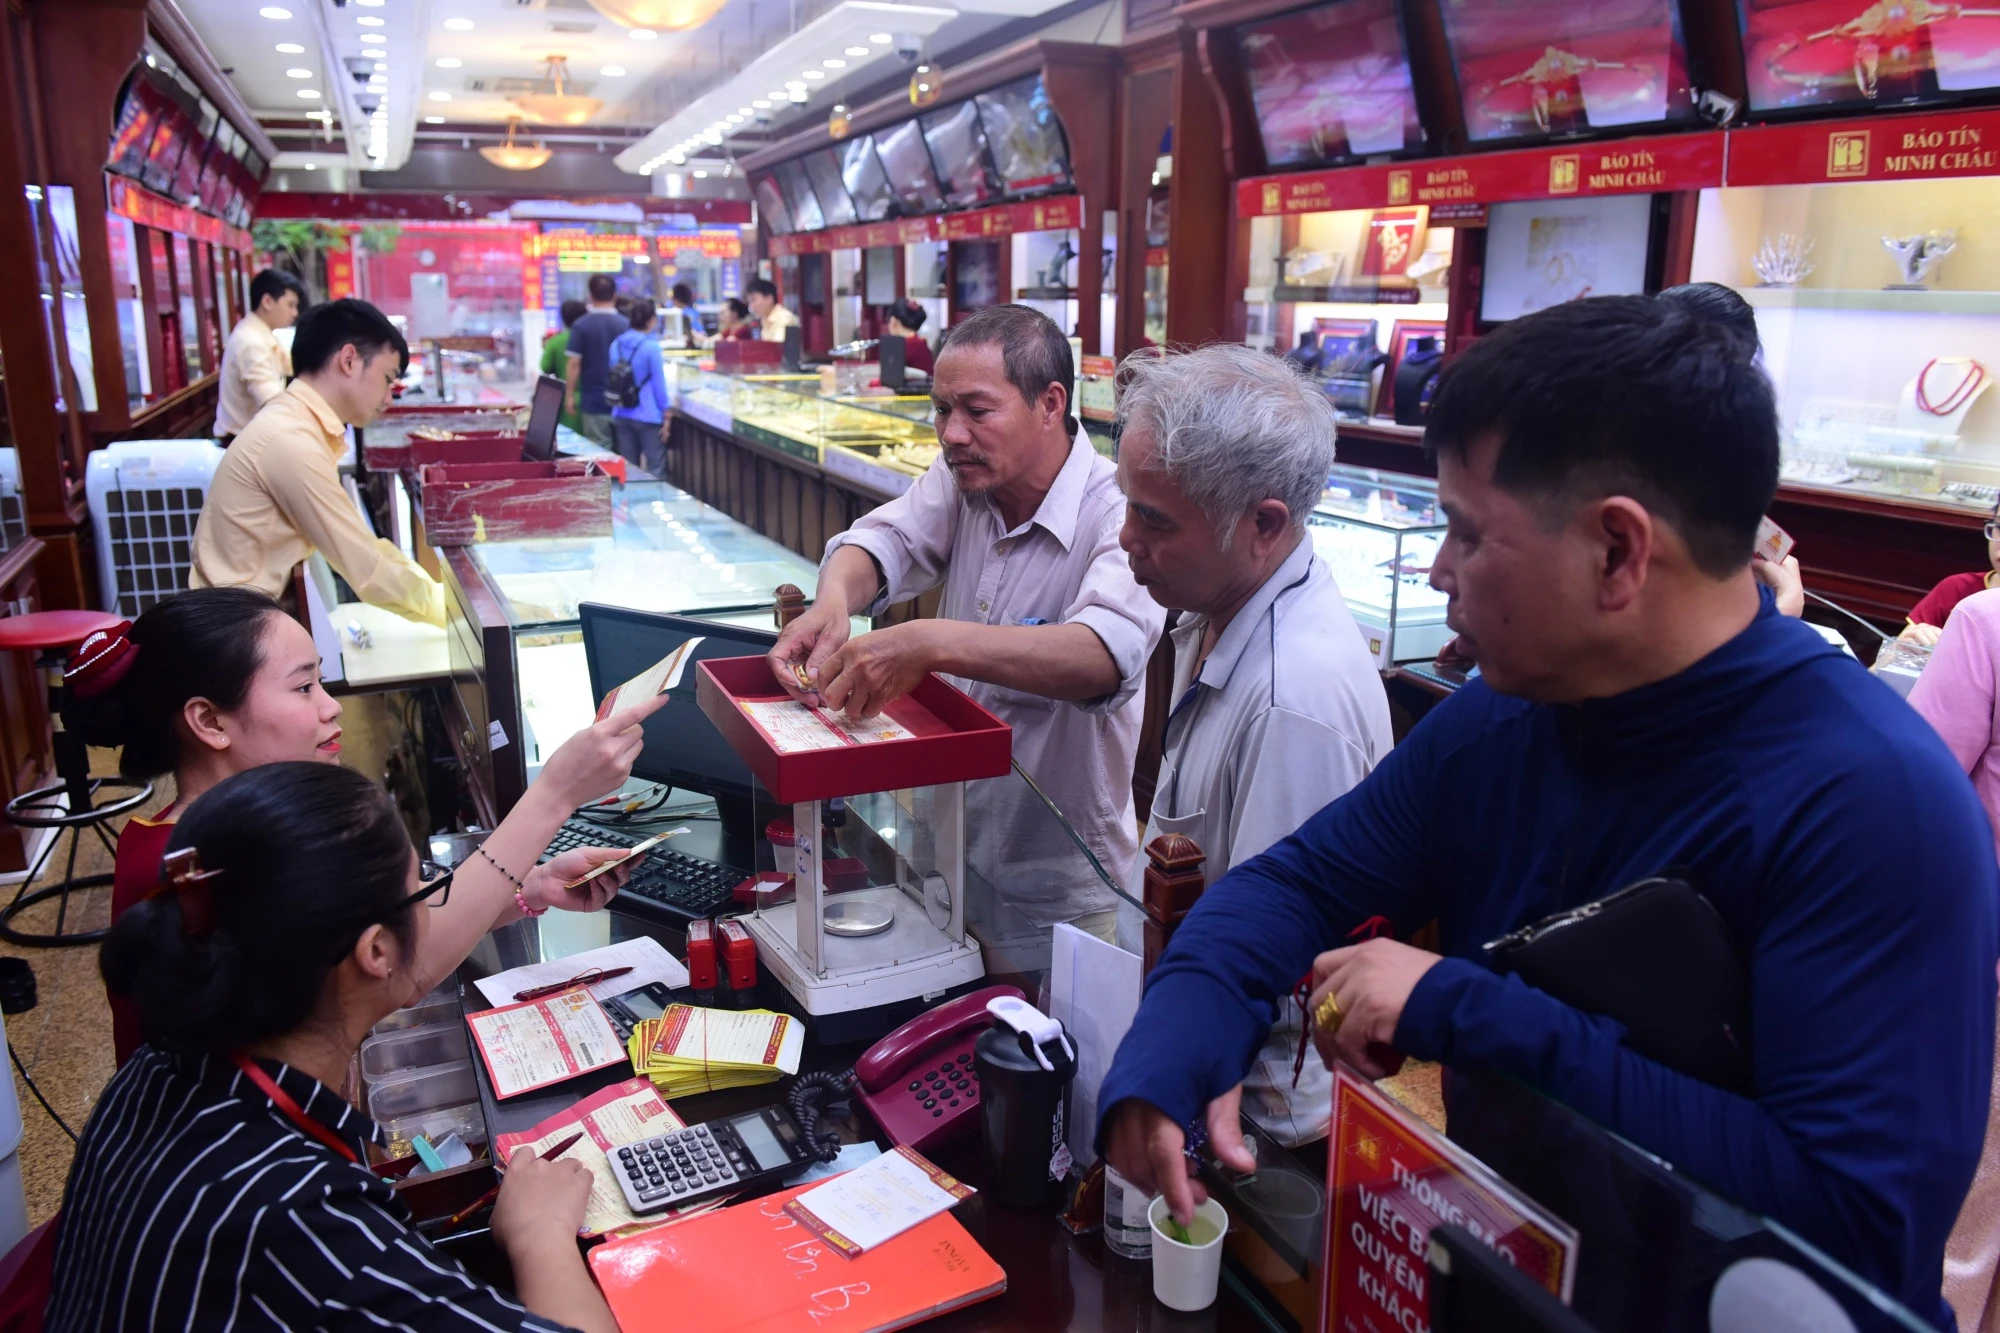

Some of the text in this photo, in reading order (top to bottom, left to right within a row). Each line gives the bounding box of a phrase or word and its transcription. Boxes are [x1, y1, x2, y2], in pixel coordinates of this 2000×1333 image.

[1902, 124, 1982, 149] BẢO TÍN
[1601, 149, 1656, 170] BẢO TÍN
[1884, 153, 1936, 173] MINH
[1588, 173, 1625, 189] MINH
[1418, 186, 1447, 200] MINH
[1390, 1157, 1463, 1226] THÔNG
[1358, 1183, 1406, 1243] VIỆC
